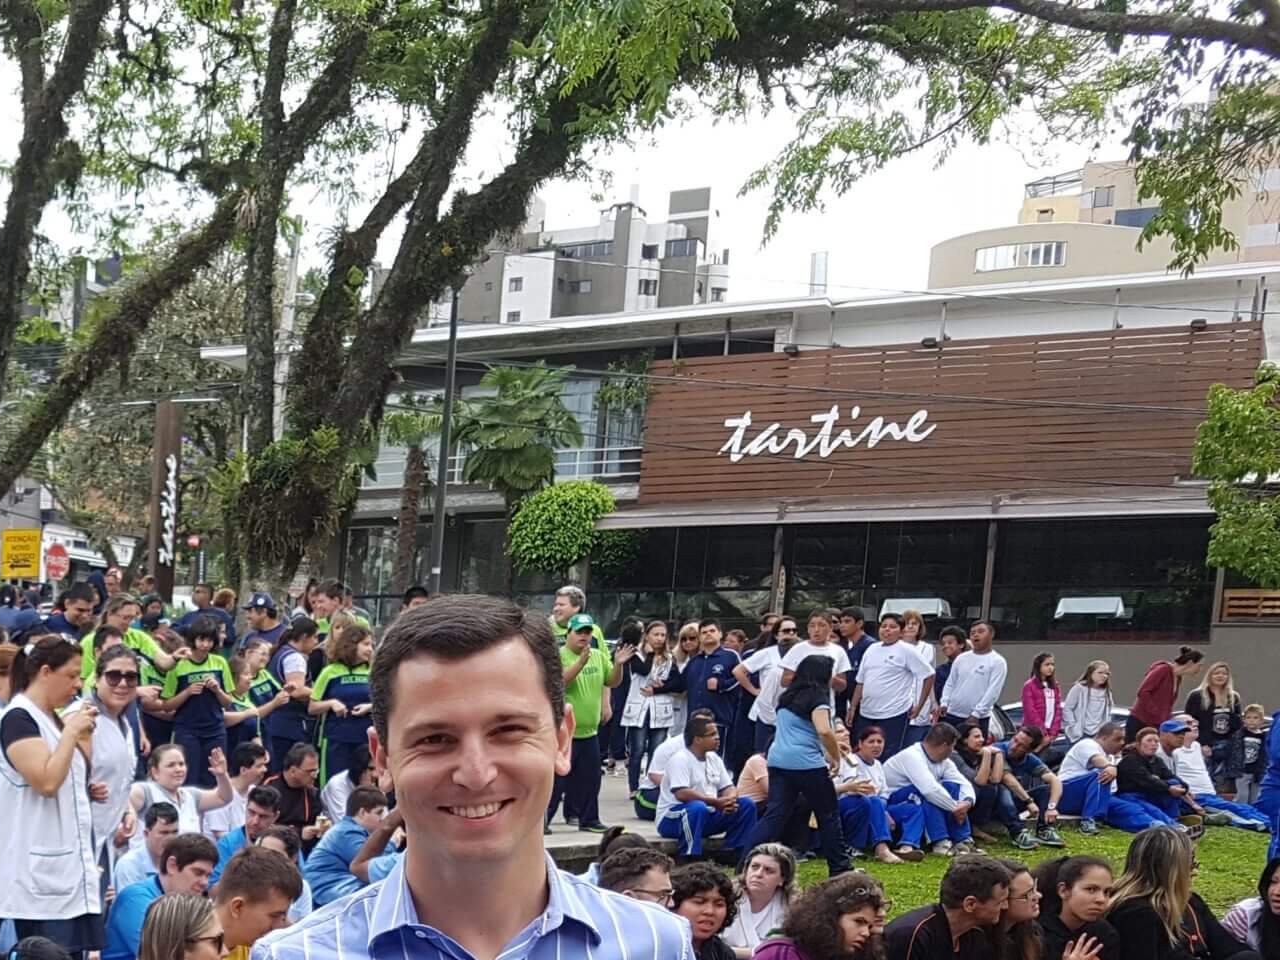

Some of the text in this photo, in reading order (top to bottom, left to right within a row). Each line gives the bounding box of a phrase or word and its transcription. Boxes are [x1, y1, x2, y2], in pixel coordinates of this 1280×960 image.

[717, 404, 937, 462] tartine
[5, 533, 38, 543] ATENÇÃO
[157, 453, 177, 567] tartine
